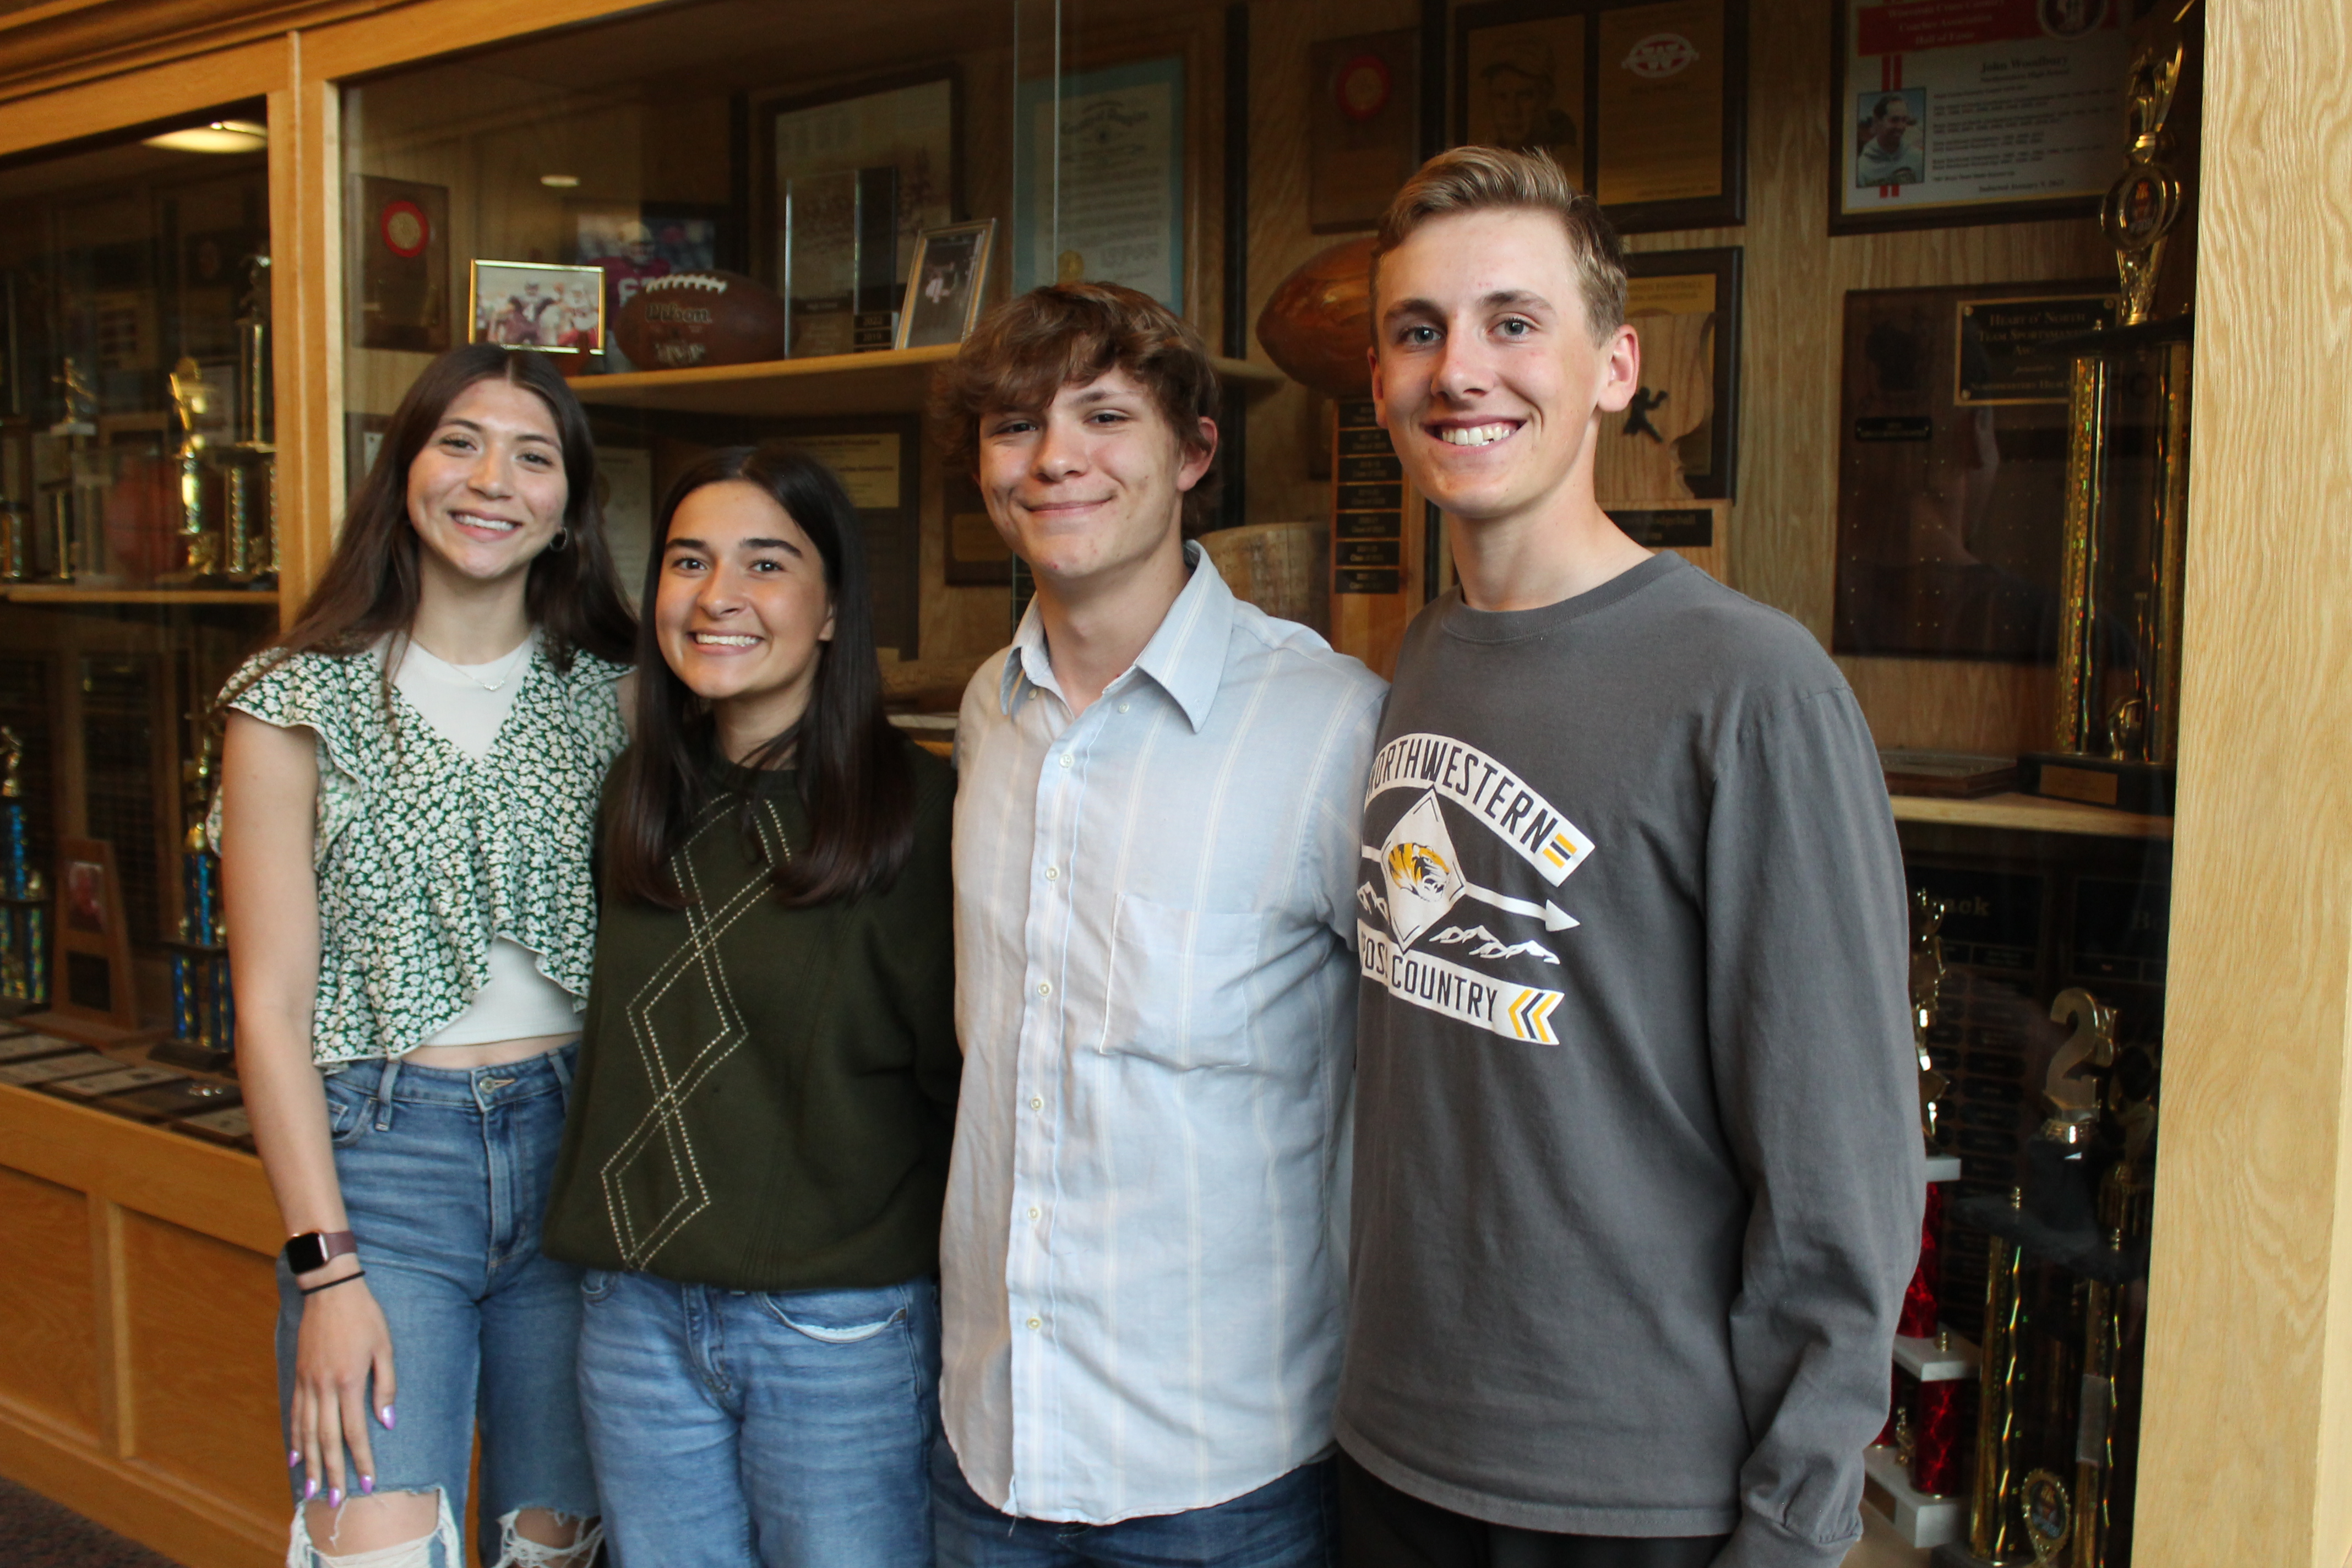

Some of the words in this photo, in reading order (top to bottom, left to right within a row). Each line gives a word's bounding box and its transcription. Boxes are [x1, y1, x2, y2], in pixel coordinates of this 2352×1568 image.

[1980, 61, 2008, 74] John
[1368, 738, 1559, 854] NORTHWESTERN
[1391, 954, 1499, 1023] COUNTRY
